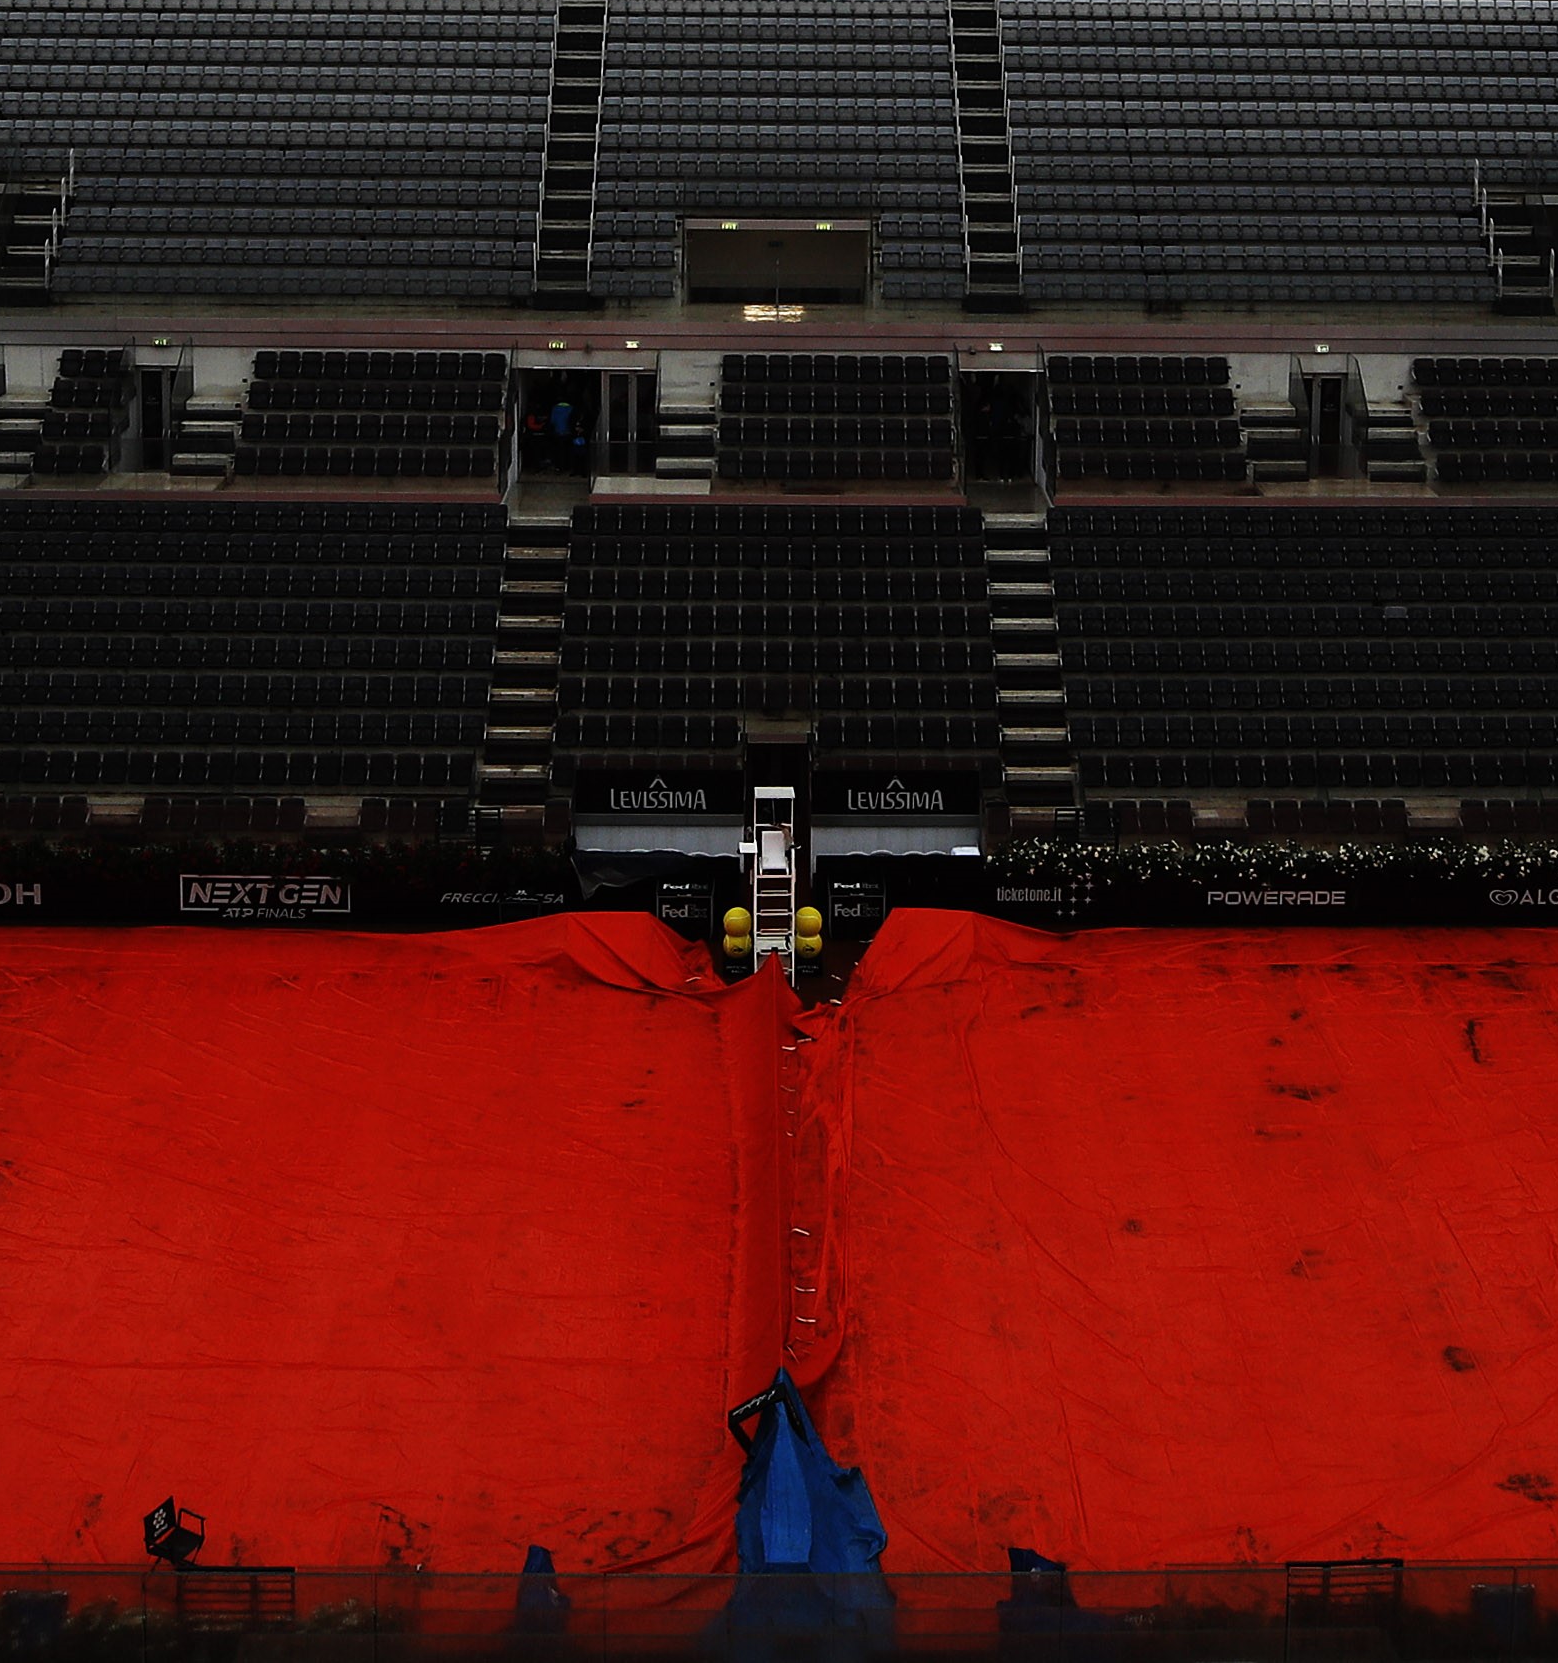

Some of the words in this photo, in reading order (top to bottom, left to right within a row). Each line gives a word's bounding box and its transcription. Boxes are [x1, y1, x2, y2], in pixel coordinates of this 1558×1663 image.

[610, 787, 707, 811] LEVISSIMA
[847, 788, 944, 811] LEVISSIMA
[189, 882, 276, 904] NEXT
[279, 884, 342, 905] GEN
[996, 886, 1062, 902] ticketone.it
[1207, 890, 1346, 906] POWERADE
[256, 908, 307, 919] FINALS
